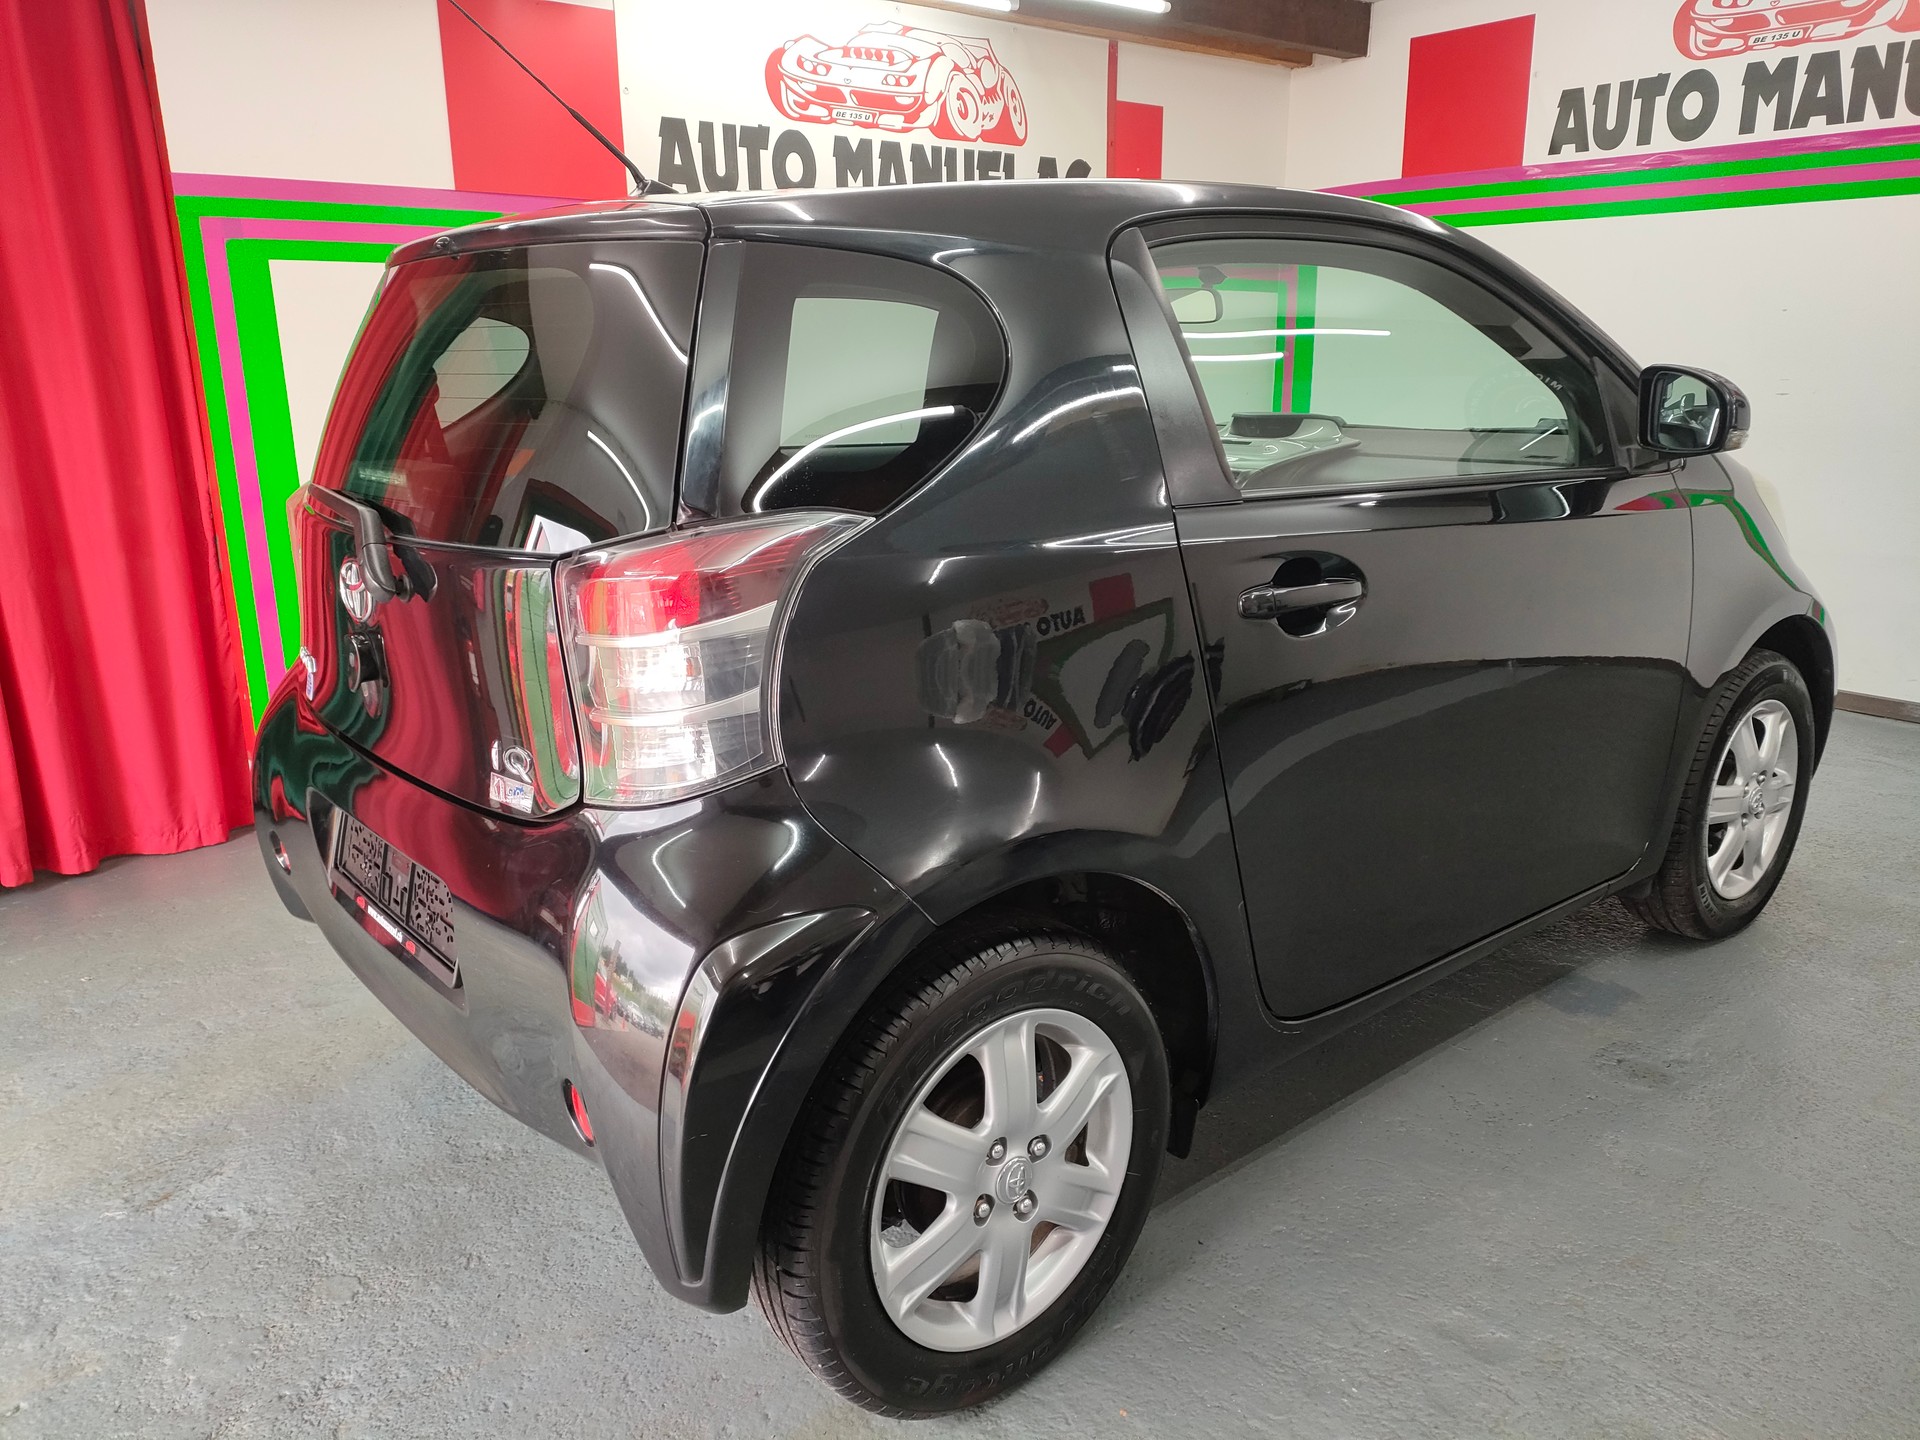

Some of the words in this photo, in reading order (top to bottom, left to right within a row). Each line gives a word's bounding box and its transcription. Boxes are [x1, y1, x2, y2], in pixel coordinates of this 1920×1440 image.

[1753, 35, 1768, 44] BE
[1771, 32, 1789, 41] 135
[1548, 68, 1720, 156] AUTO
[658, 116, 817, 193] AUTO
